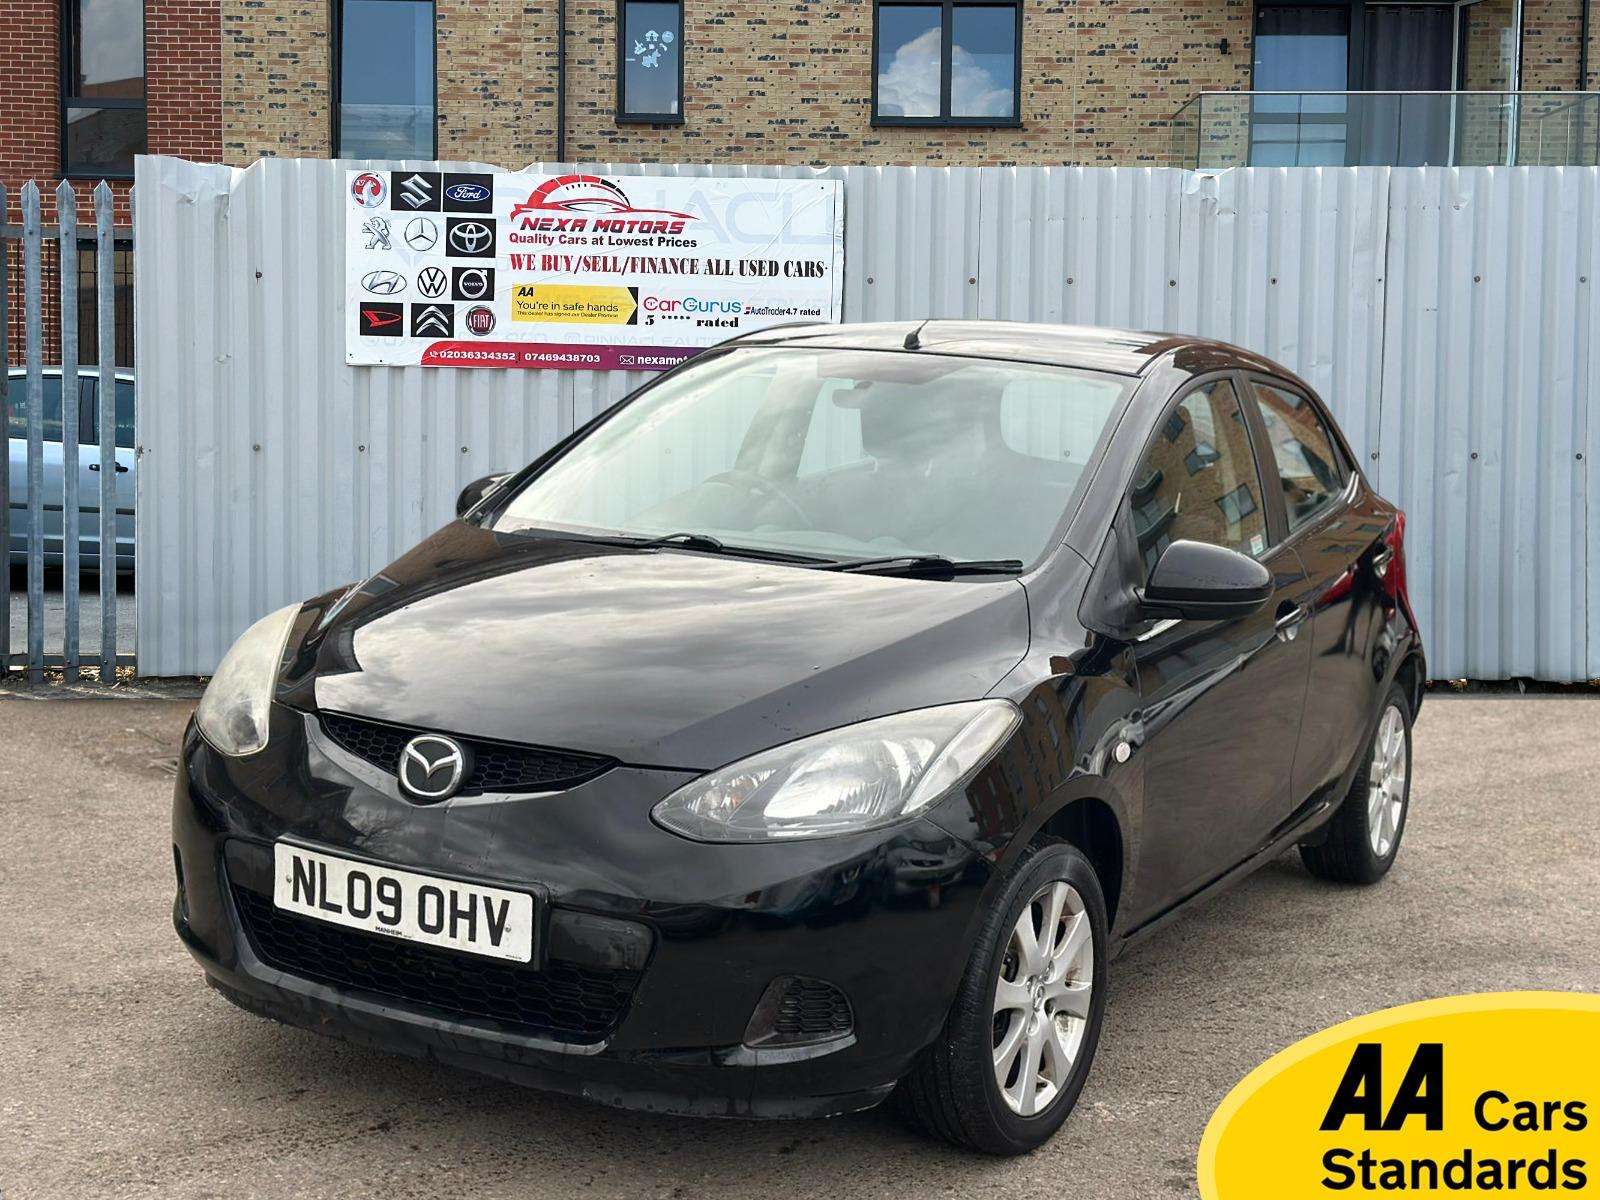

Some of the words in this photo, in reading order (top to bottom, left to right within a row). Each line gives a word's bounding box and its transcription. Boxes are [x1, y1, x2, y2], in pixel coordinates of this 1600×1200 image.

[454, 186, 482, 199] Ford
[519, 217, 588, 232] NEXA
[592, 219, 686, 235] MOTORS
[509, 232, 554, 246] Quality
[558, 234, 588, 245] Cars
[591, 235, 604, 246] at
[608, 236, 654, 246] Lowest
[657, 237, 698, 248] Prices
[510, 254, 536, 271] WE
[541, 254, 699, 276] BUY/SELL/FINANCE
[704, 258, 734, 276] ALL
[739, 259, 779, 277] USED
[784, 260, 825, 278] CARS
[517, 286, 534, 297] AA
[517, 300, 549, 310] You're
[551, 301, 561, 310] in
[563, 301, 585, 311] safe
[587, 301, 619, 312] hands
[643, 296, 742, 314] CarGurus
[799, 308, 821, 316] rated
[473, 314, 490, 328] FIAT
[645, 314, 655, 326] 5
[696, 317, 739, 328] rated
[524, 353, 601, 363] 07469438703
[291, 855, 402, 927] NL09
[417, 884, 511, 947] OHV
